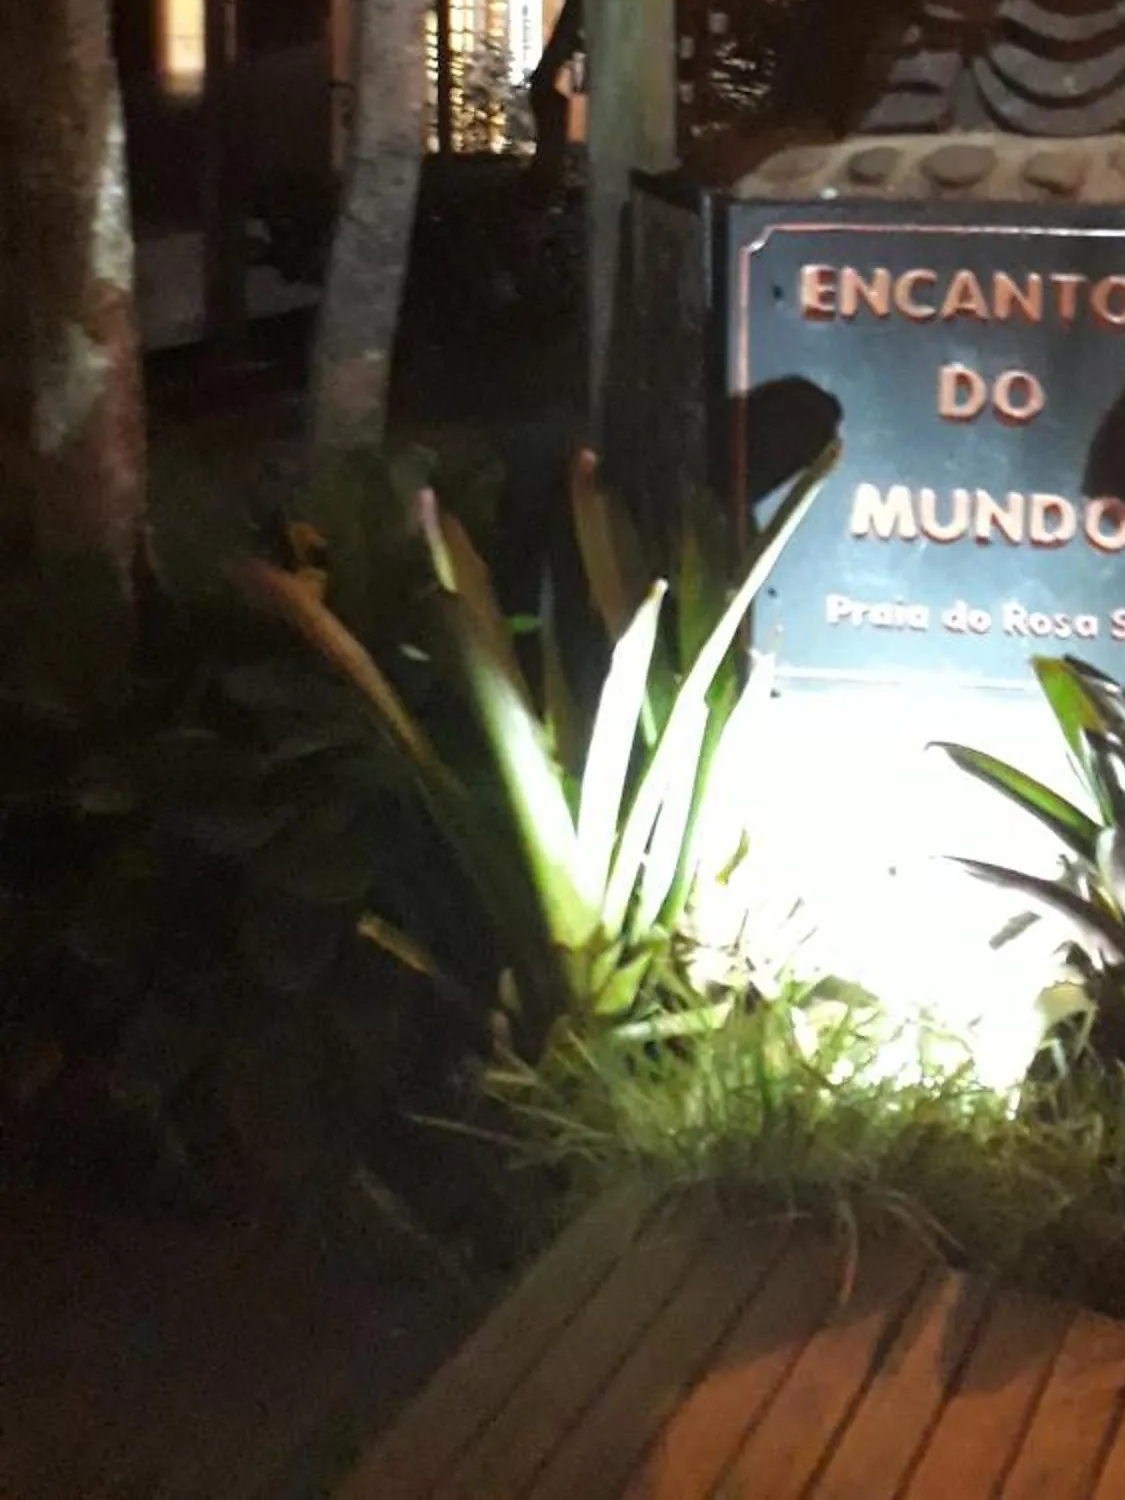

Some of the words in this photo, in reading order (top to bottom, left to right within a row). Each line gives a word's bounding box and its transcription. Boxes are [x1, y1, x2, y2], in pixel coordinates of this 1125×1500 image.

[937, 361, 1046, 422] DO
[826, 594, 930, 630] Praia
[941, 599, 992, 635] do
[1002, 601, 1099, 640] Rosa
